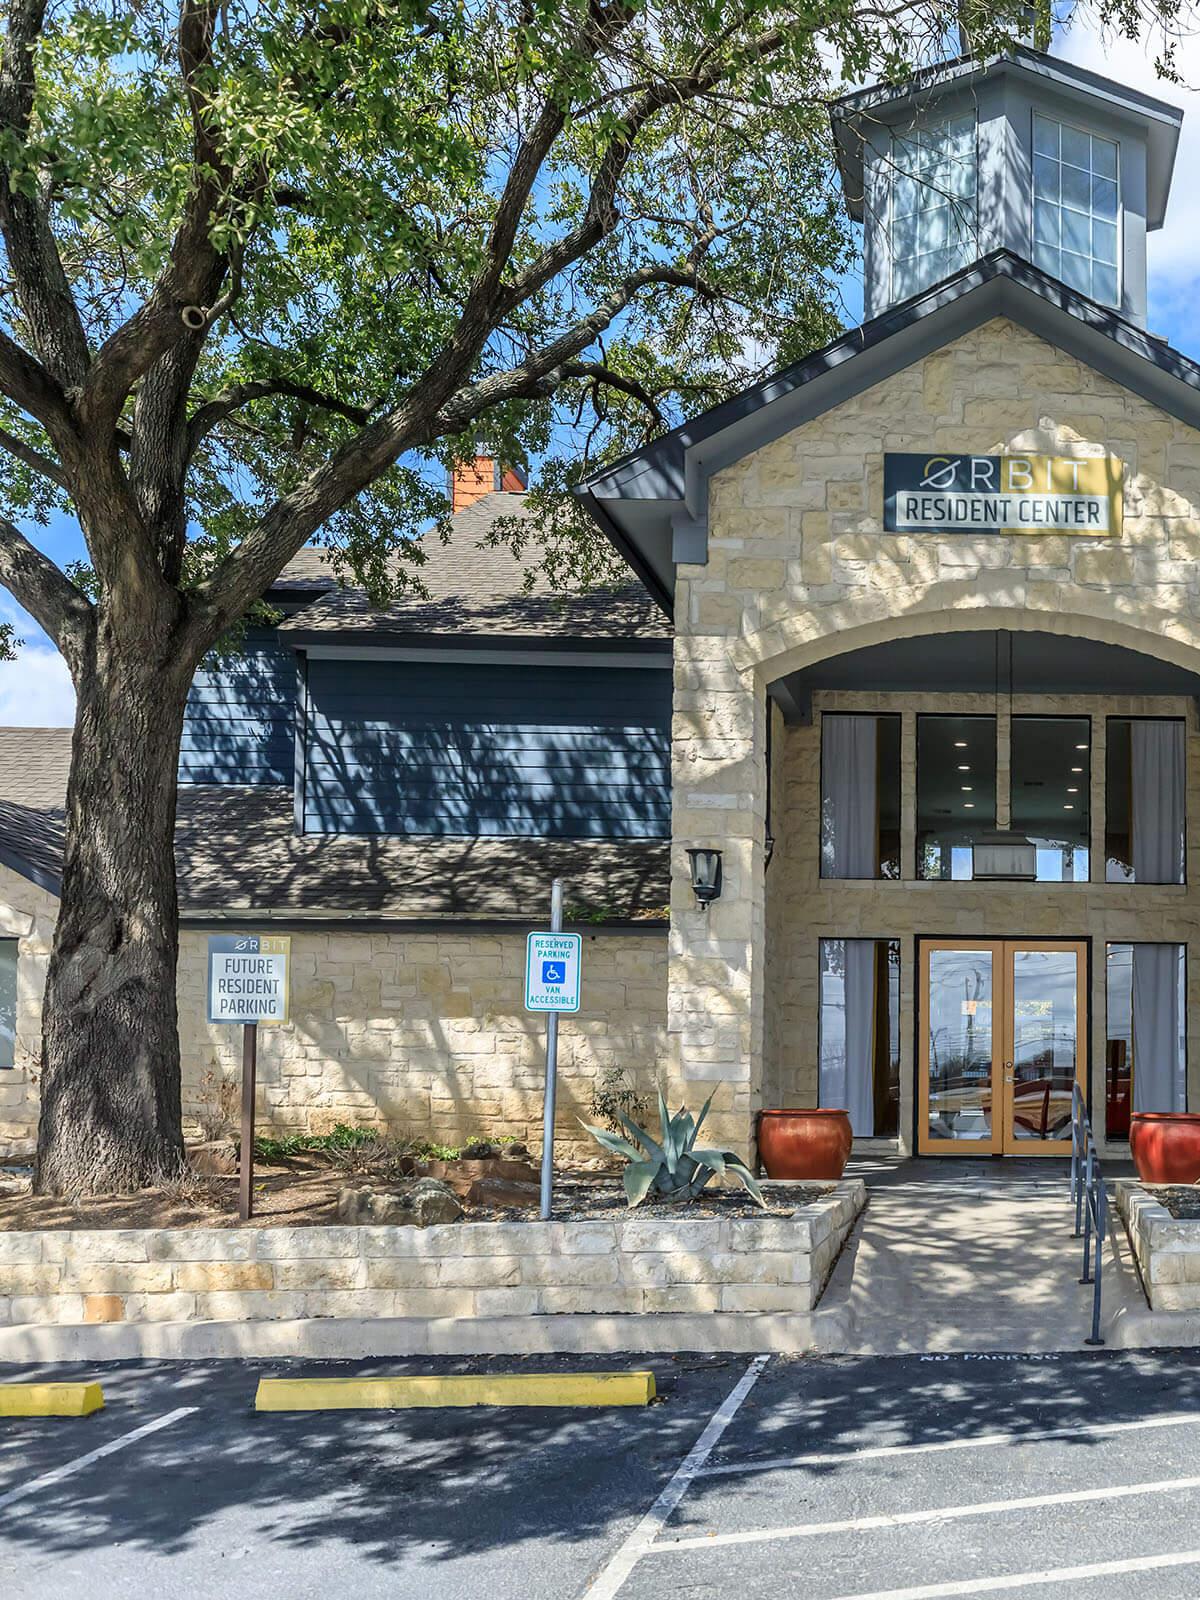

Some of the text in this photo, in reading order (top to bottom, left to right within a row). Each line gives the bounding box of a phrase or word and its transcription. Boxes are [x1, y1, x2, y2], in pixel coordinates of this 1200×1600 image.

[905, 497, 1100, 524] RESIDENT CENTER
[535, 940, 574, 949] RESERVED
[537, 950, 571, 959] PARKING
[225, 958, 273, 974] FUTURE
[218, 978, 280, 995] RESIDENT
[545, 986, 560, 994] VAN
[220, 998, 277, 1015] PARKING
[530, 995, 575, 1005] ACCESSIBLE
